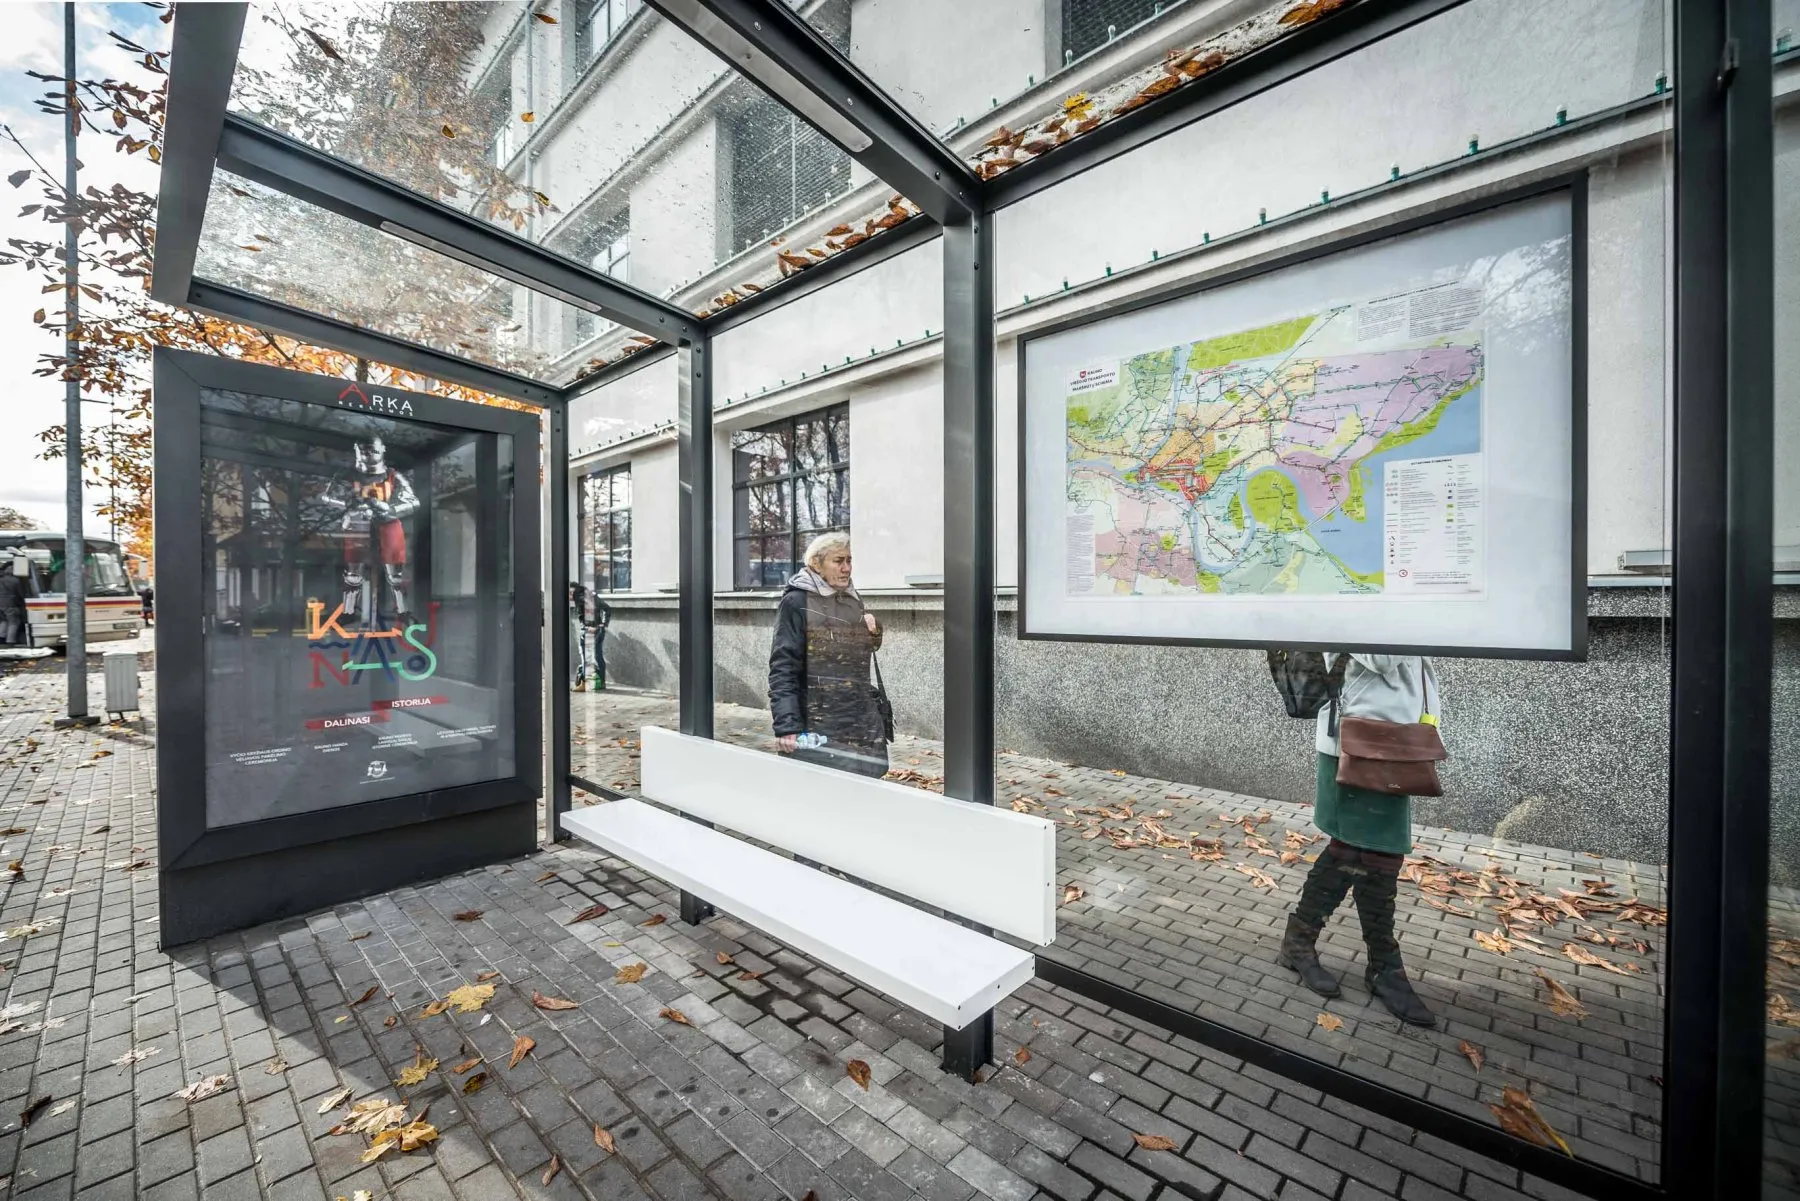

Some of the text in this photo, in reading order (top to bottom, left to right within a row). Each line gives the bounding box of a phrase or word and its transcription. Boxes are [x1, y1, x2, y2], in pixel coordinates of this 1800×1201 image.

[338, 383, 413, 412] ARKA
[338, 401, 413, 417] REKLAMOS
[391, 697, 432, 708] ISTORIJA
[324, 716, 371, 728] DALINASI
